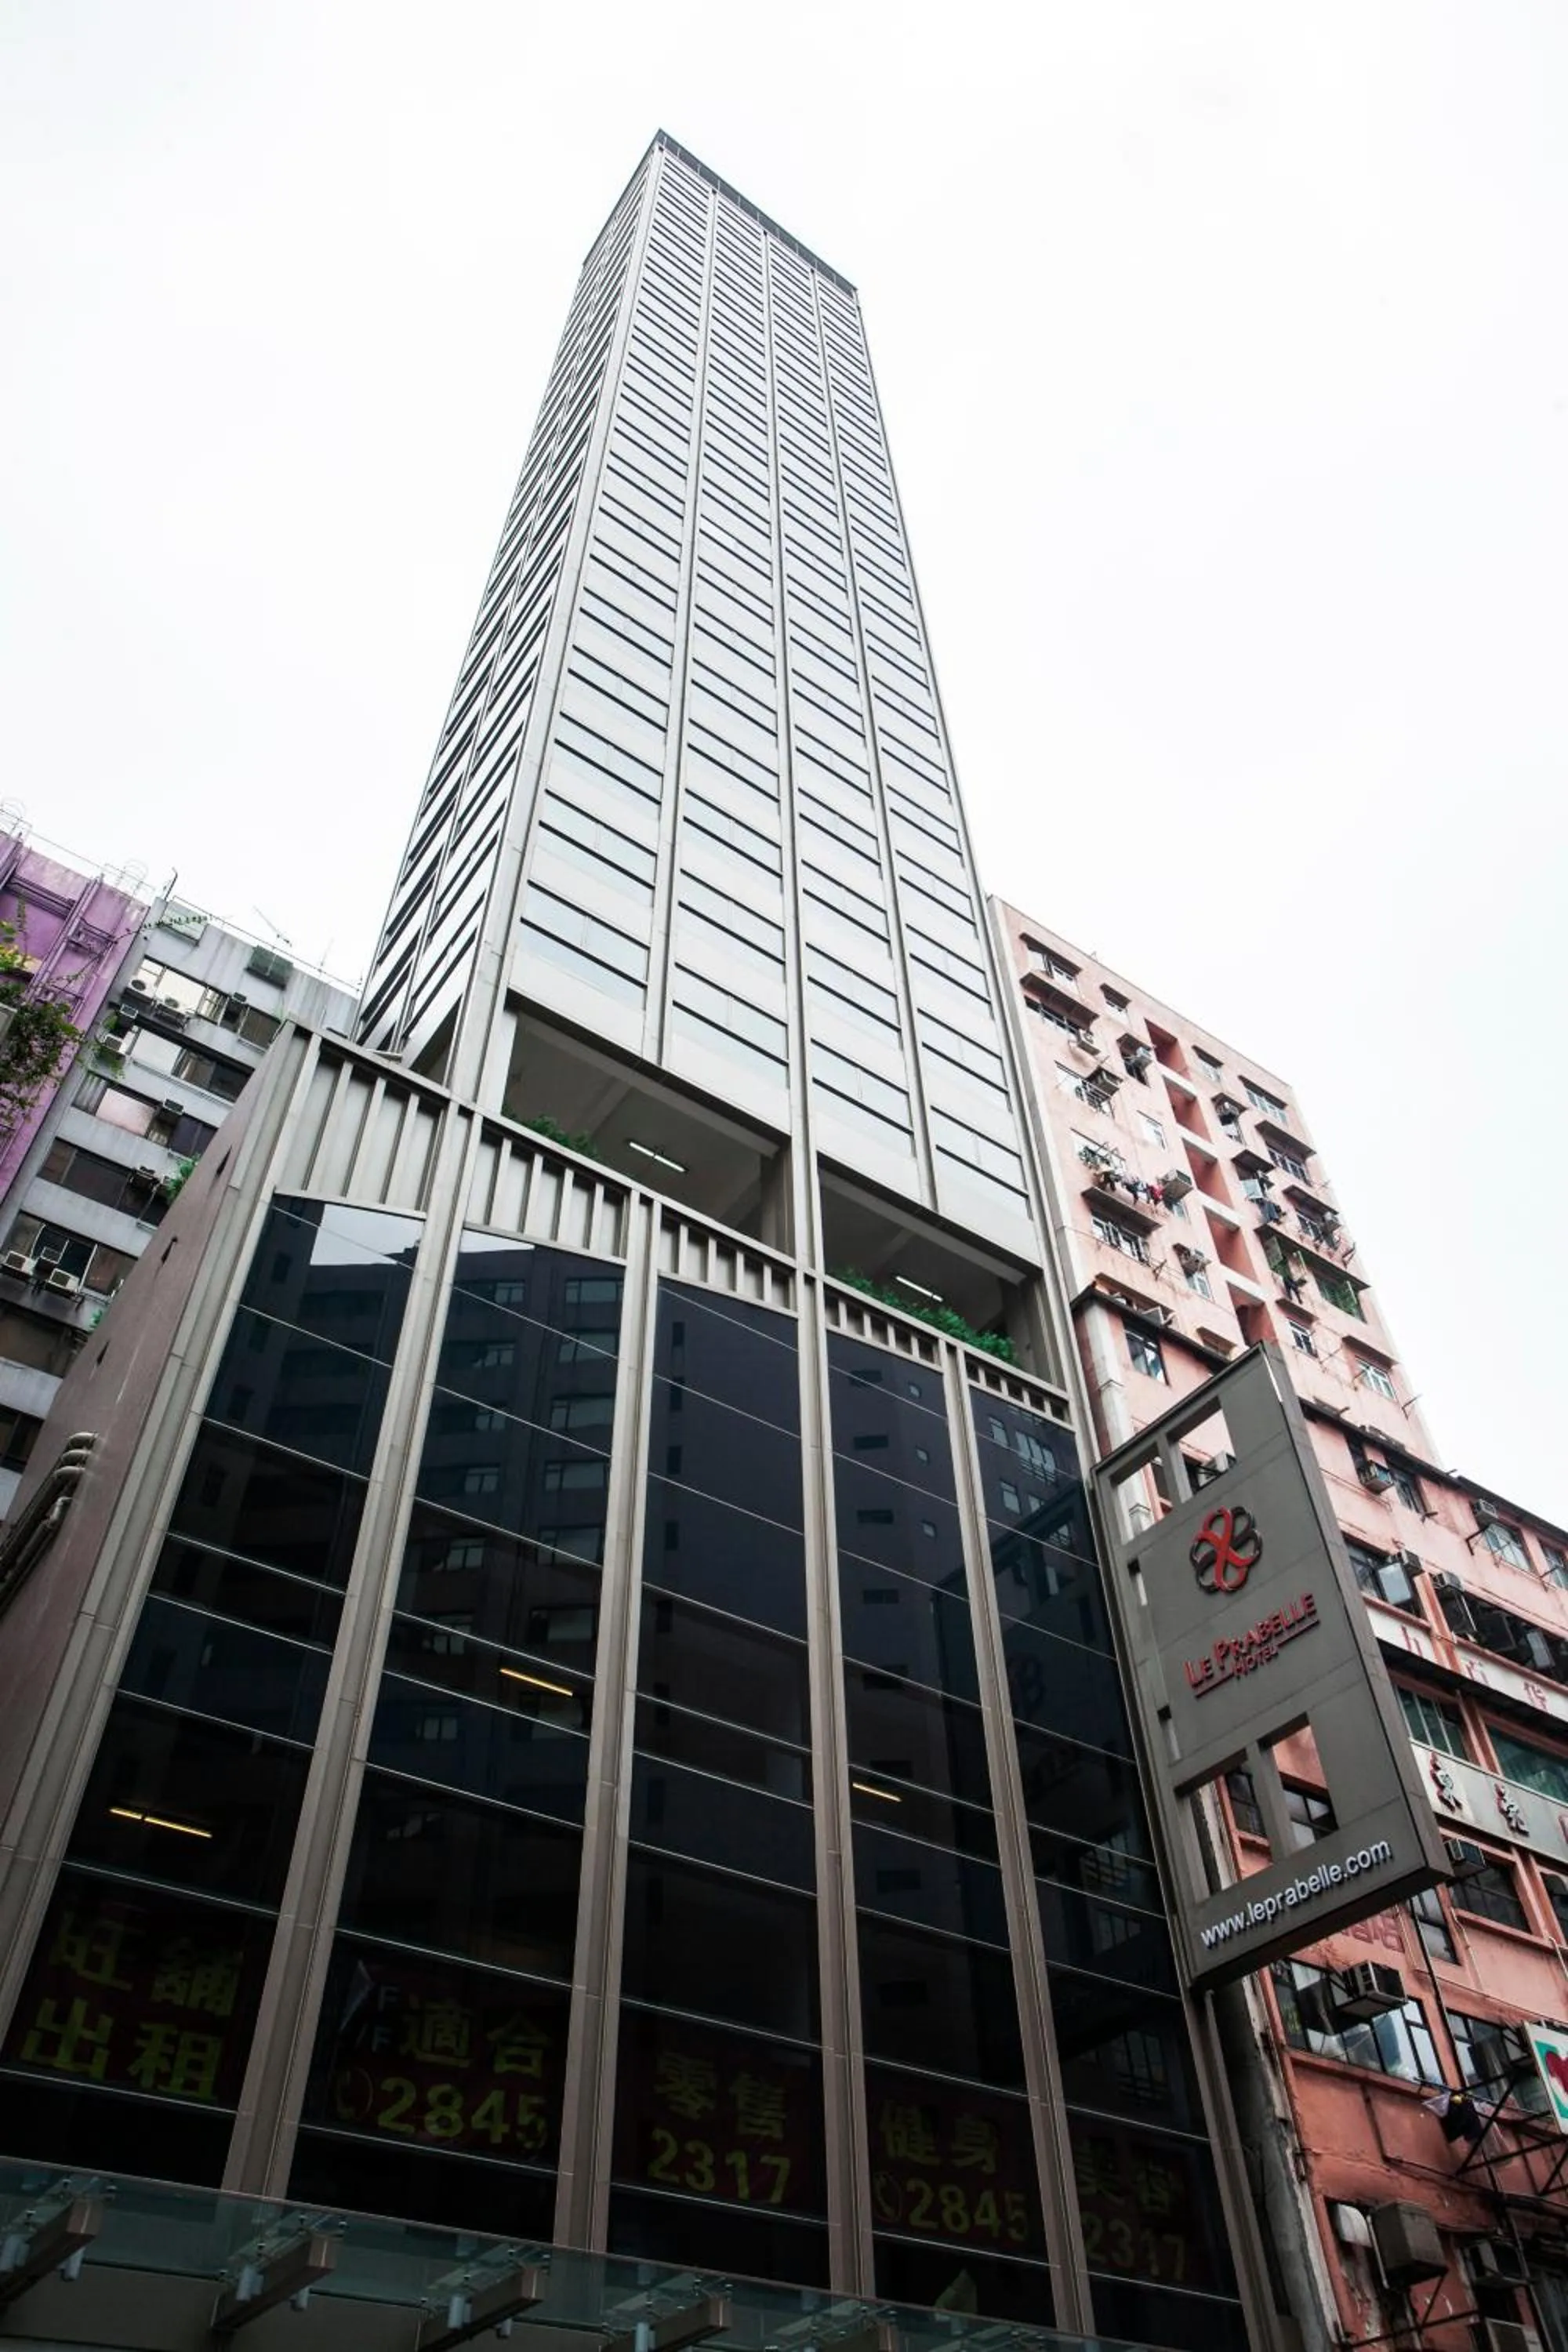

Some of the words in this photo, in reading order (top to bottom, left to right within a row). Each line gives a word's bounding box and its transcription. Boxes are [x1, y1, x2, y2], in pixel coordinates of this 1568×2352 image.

[1184, 1657, 1214, 1687] LE
[1214, 1592, 1317, 1671] PRABELLE
[1232, 1645, 1279, 1679] HOTEL
[1200, 1840, 1393, 1950] www.leprabelle.com
[20, 1996, 226, 2100] 出租
[398, 1993, 554, 2079] 適合
[880, 2098, 1000, 2176] 健身
[377, 2076, 547, 2150] 2845
[647, 2126, 792, 2205] 2317
[906, 2176, 1029, 2242] 2845
[1080, 2209, 1187, 2283] 2317
